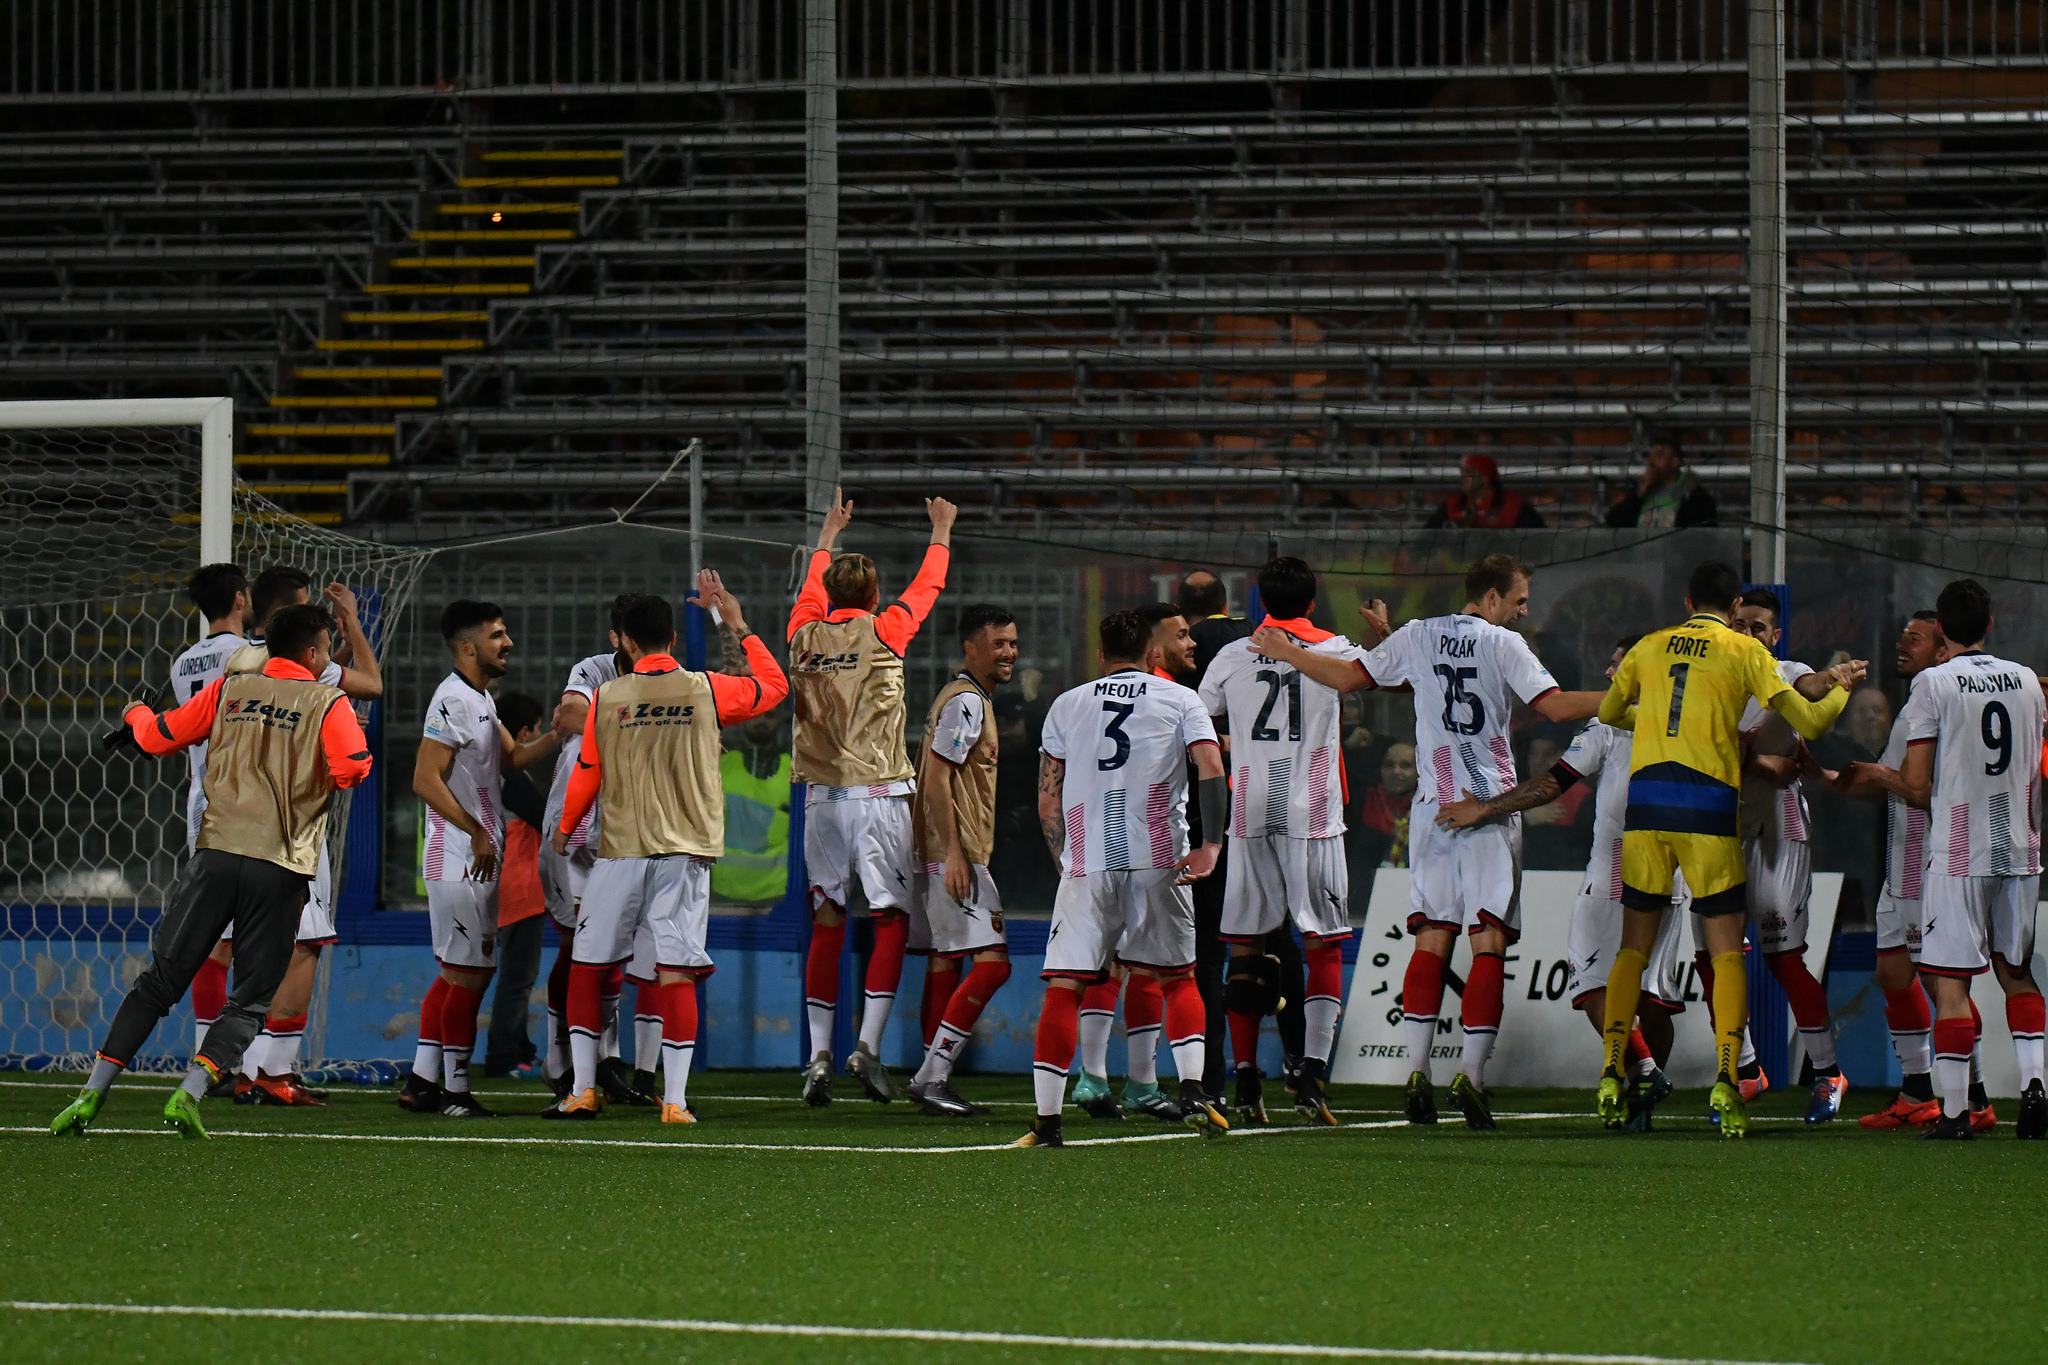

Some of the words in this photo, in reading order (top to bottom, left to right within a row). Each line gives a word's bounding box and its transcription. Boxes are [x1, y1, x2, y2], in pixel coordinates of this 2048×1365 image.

[1666, 635, 1710, 658] FORTE
[179, 650, 223, 677] LORENZINI
[1094, 682, 1147, 698] MEOLA
[1956, 671, 2023, 693] PADOVAN
[241, 699, 302, 722] Zeus
[635, 703, 695, 718] Zeus
[1251, 669, 1301, 742] 21
[1433, 663, 1486, 736] 25
[1665, 662, 1690, 737] 1
[1097, 700, 1135, 771] 3
[1981, 700, 2012, 776] 9
[1358, 1044, 1409, 1058] STREE
